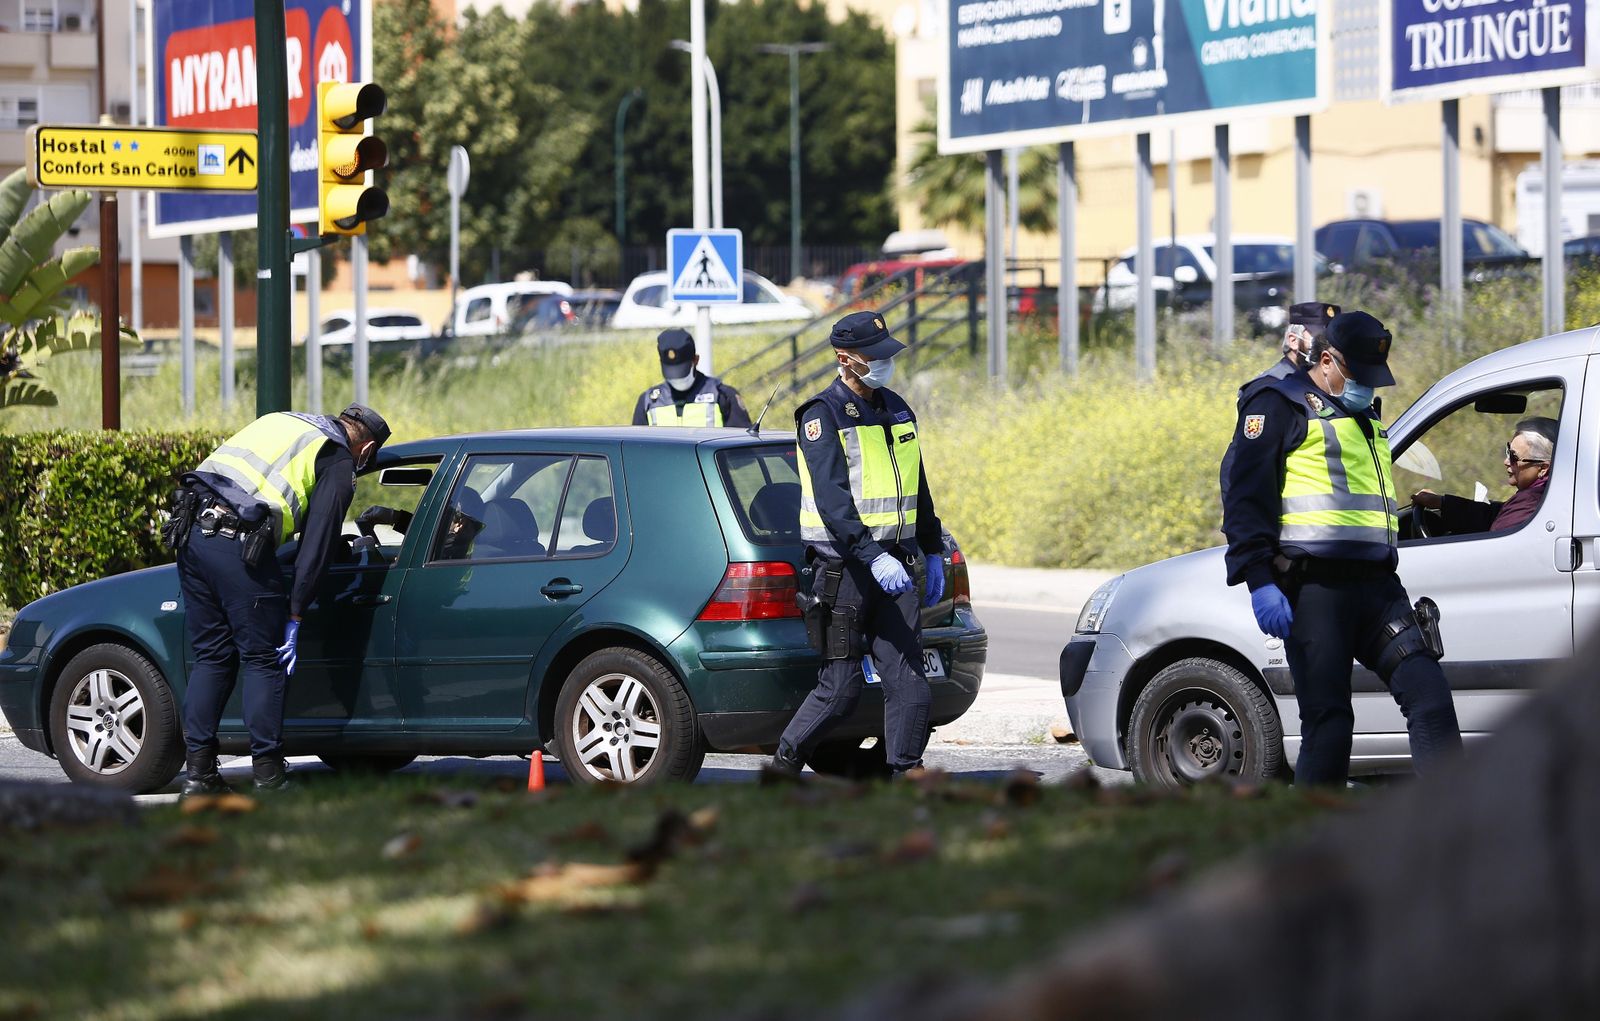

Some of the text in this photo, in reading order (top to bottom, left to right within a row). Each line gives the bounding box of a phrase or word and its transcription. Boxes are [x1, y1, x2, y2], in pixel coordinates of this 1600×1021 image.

[1405, 0, 1572, 71] TRILINGÜE
[171, 36, 303, 118] MYRAMR
[42, 138, 106, 154] Hostal
[163, 146, 196, 157] 400m
[43, 160, 197, 178] Confort San Carlos
